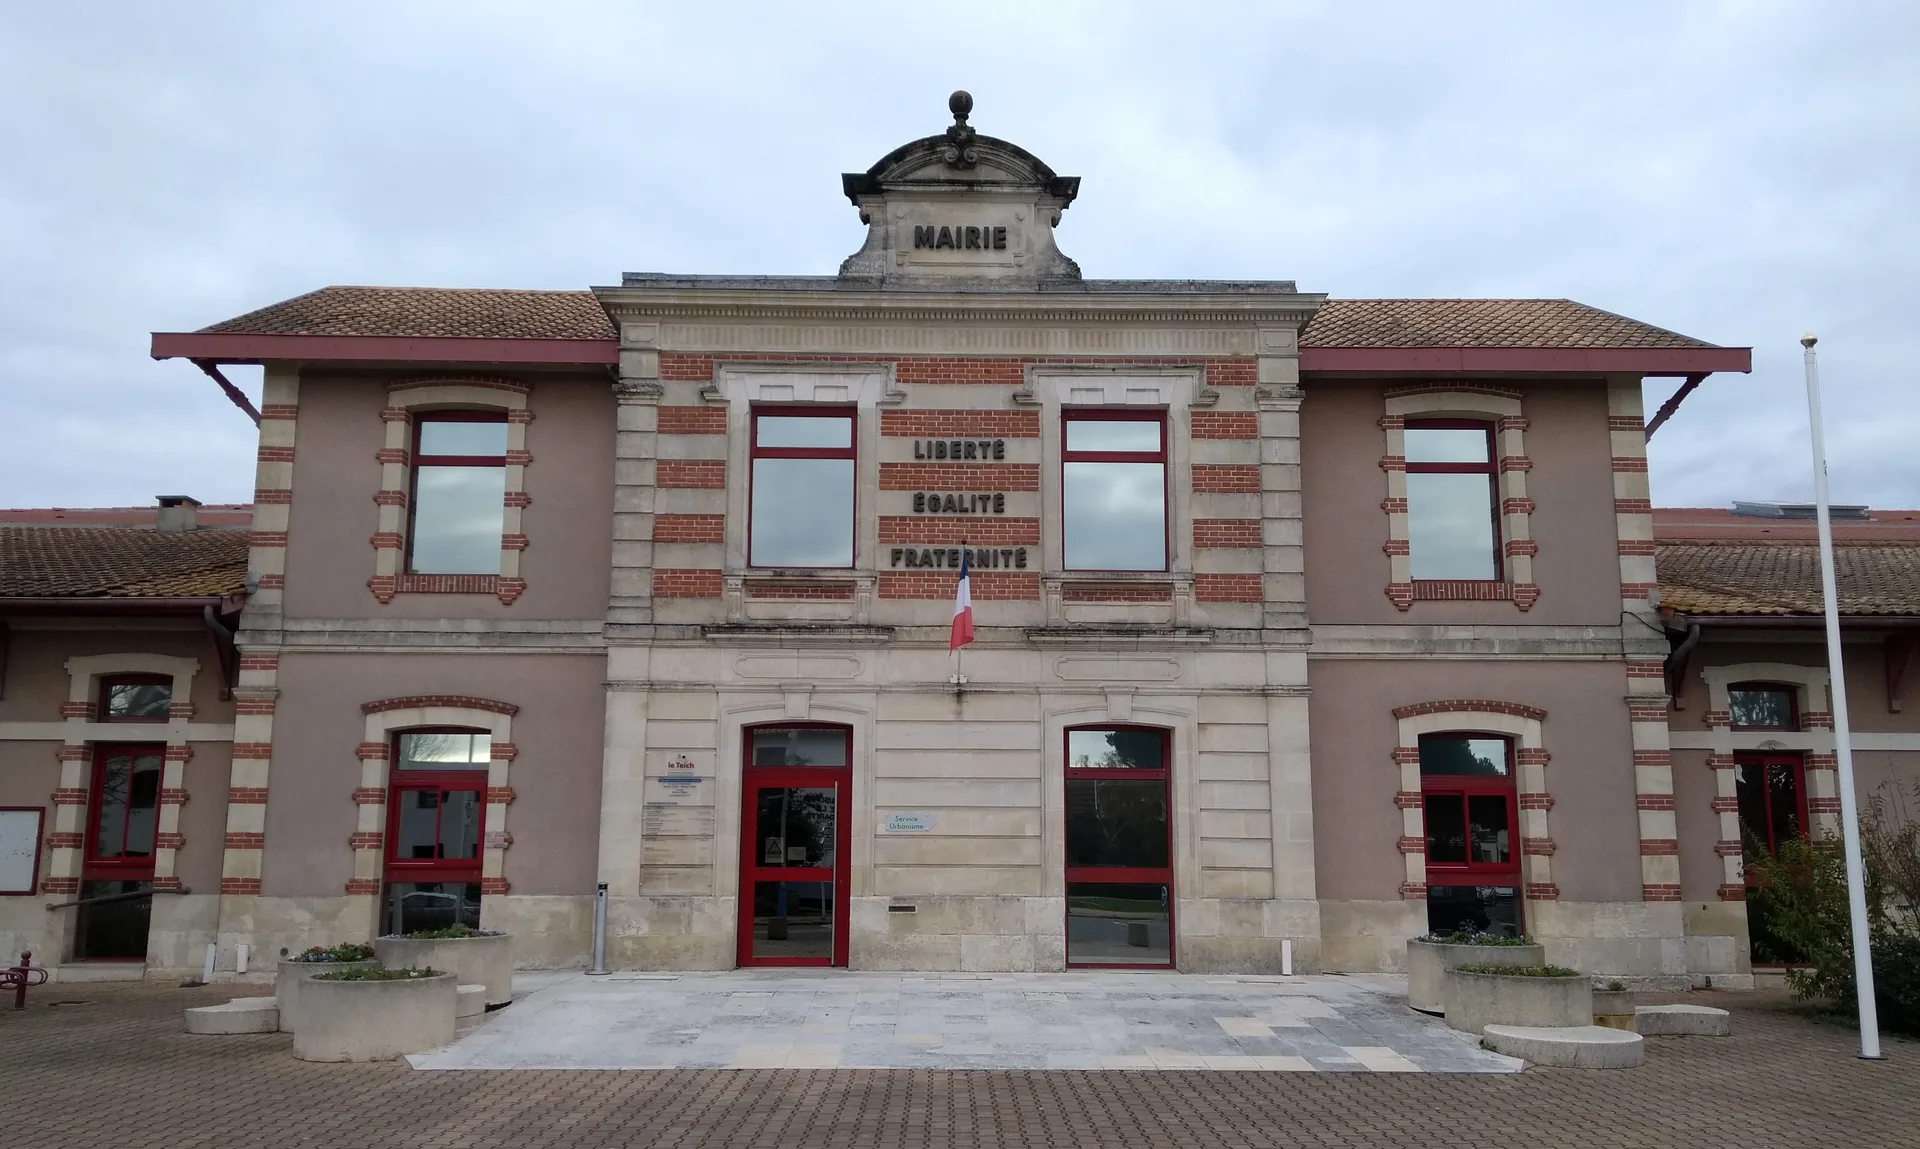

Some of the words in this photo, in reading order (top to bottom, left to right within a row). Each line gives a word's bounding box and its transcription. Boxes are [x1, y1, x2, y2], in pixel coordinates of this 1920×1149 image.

[914, 225, 1006, 249] MAIRIE
[914, 438, 1005, 460] LIBERTÉ
[913, 491, 1005, 513] ÉGALITÉ
[890, 547, 1027, 569] FRATERNITÉ
[668, 761, 675, 769] le
[676, 761, 695, 769] Teich
